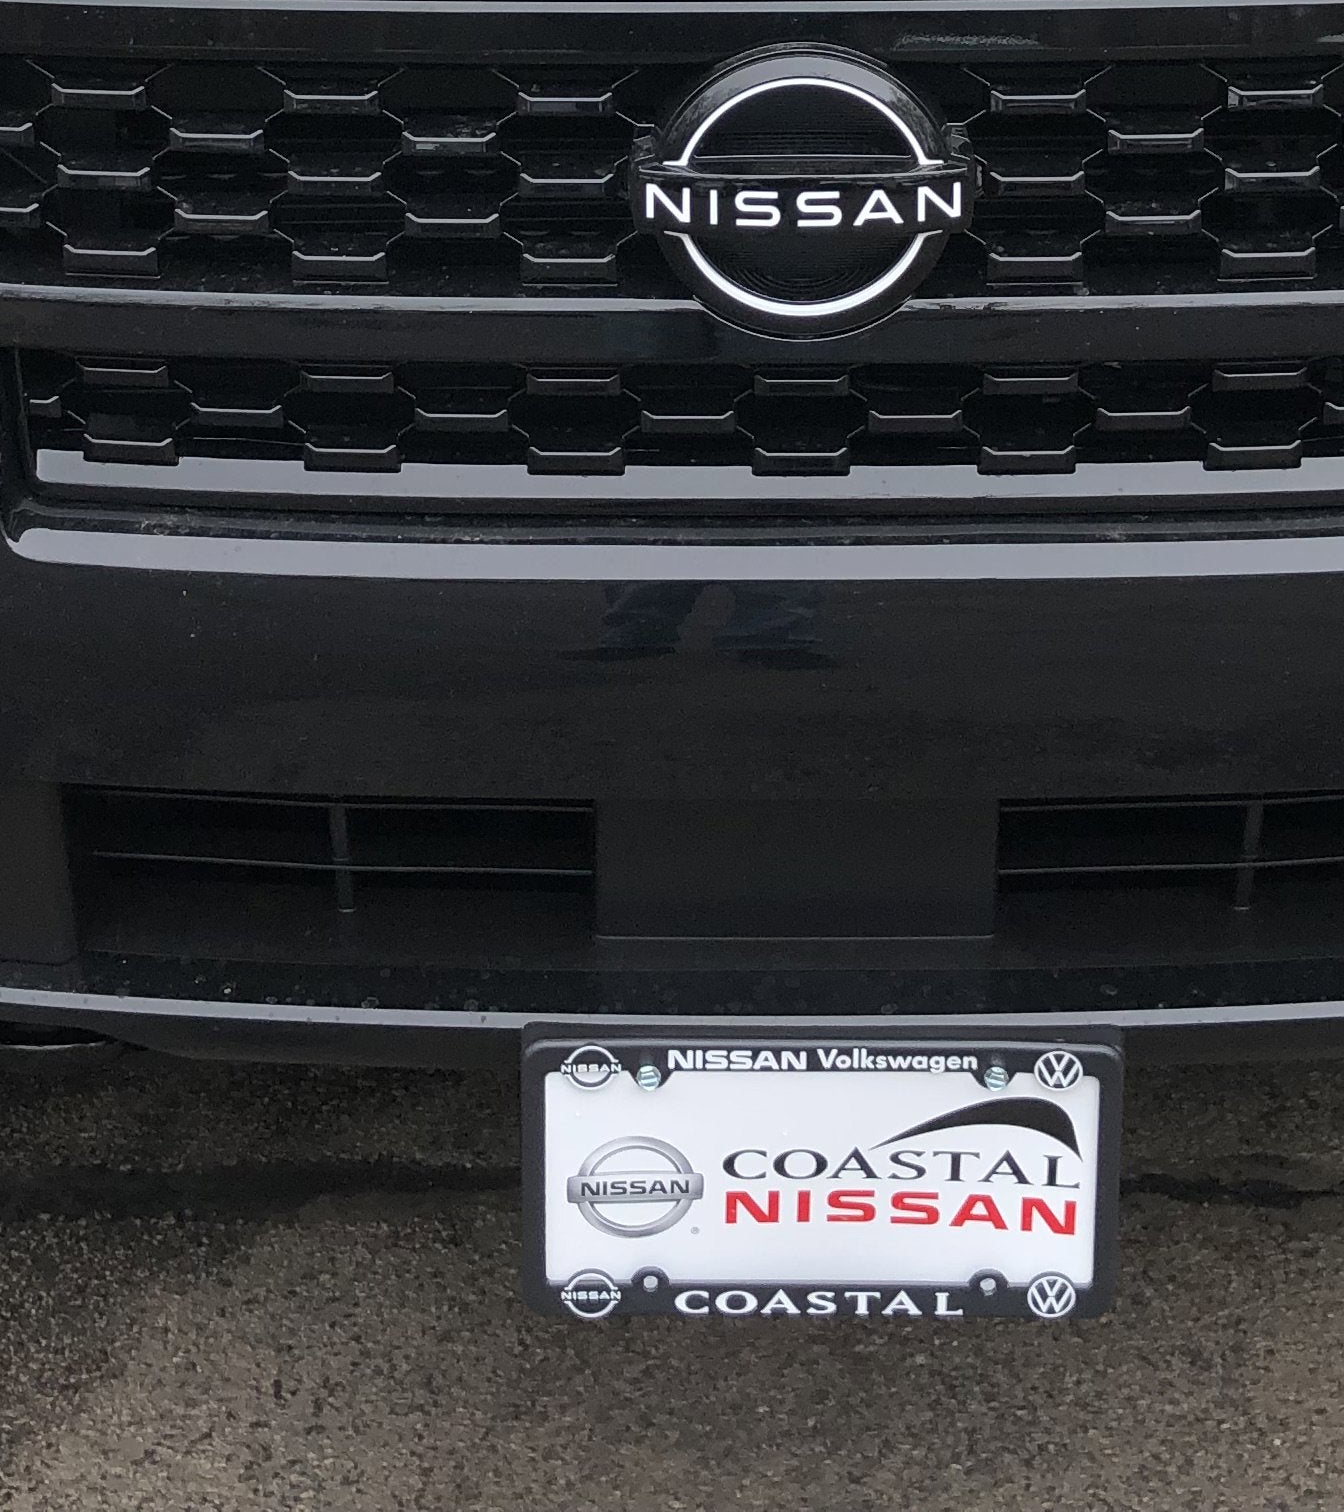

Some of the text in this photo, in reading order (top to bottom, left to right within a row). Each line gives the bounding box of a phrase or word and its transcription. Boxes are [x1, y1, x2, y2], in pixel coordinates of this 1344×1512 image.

[645, 182, 962, 227] NISSAN
[560, 1063, 622, 1073] NISSAN
[667, 1048, 978, 1073] NISSAN Volkswagen
[722, 1146, 1080, 1189] COASTAL
[580, 1179, 690, 1197] NISSAN
[725, 1190, 1077, 1235] NISSAN
[560, 1290, 622, 1300] NISSAN
[674, 1289, 964, 1316] COASTAL
